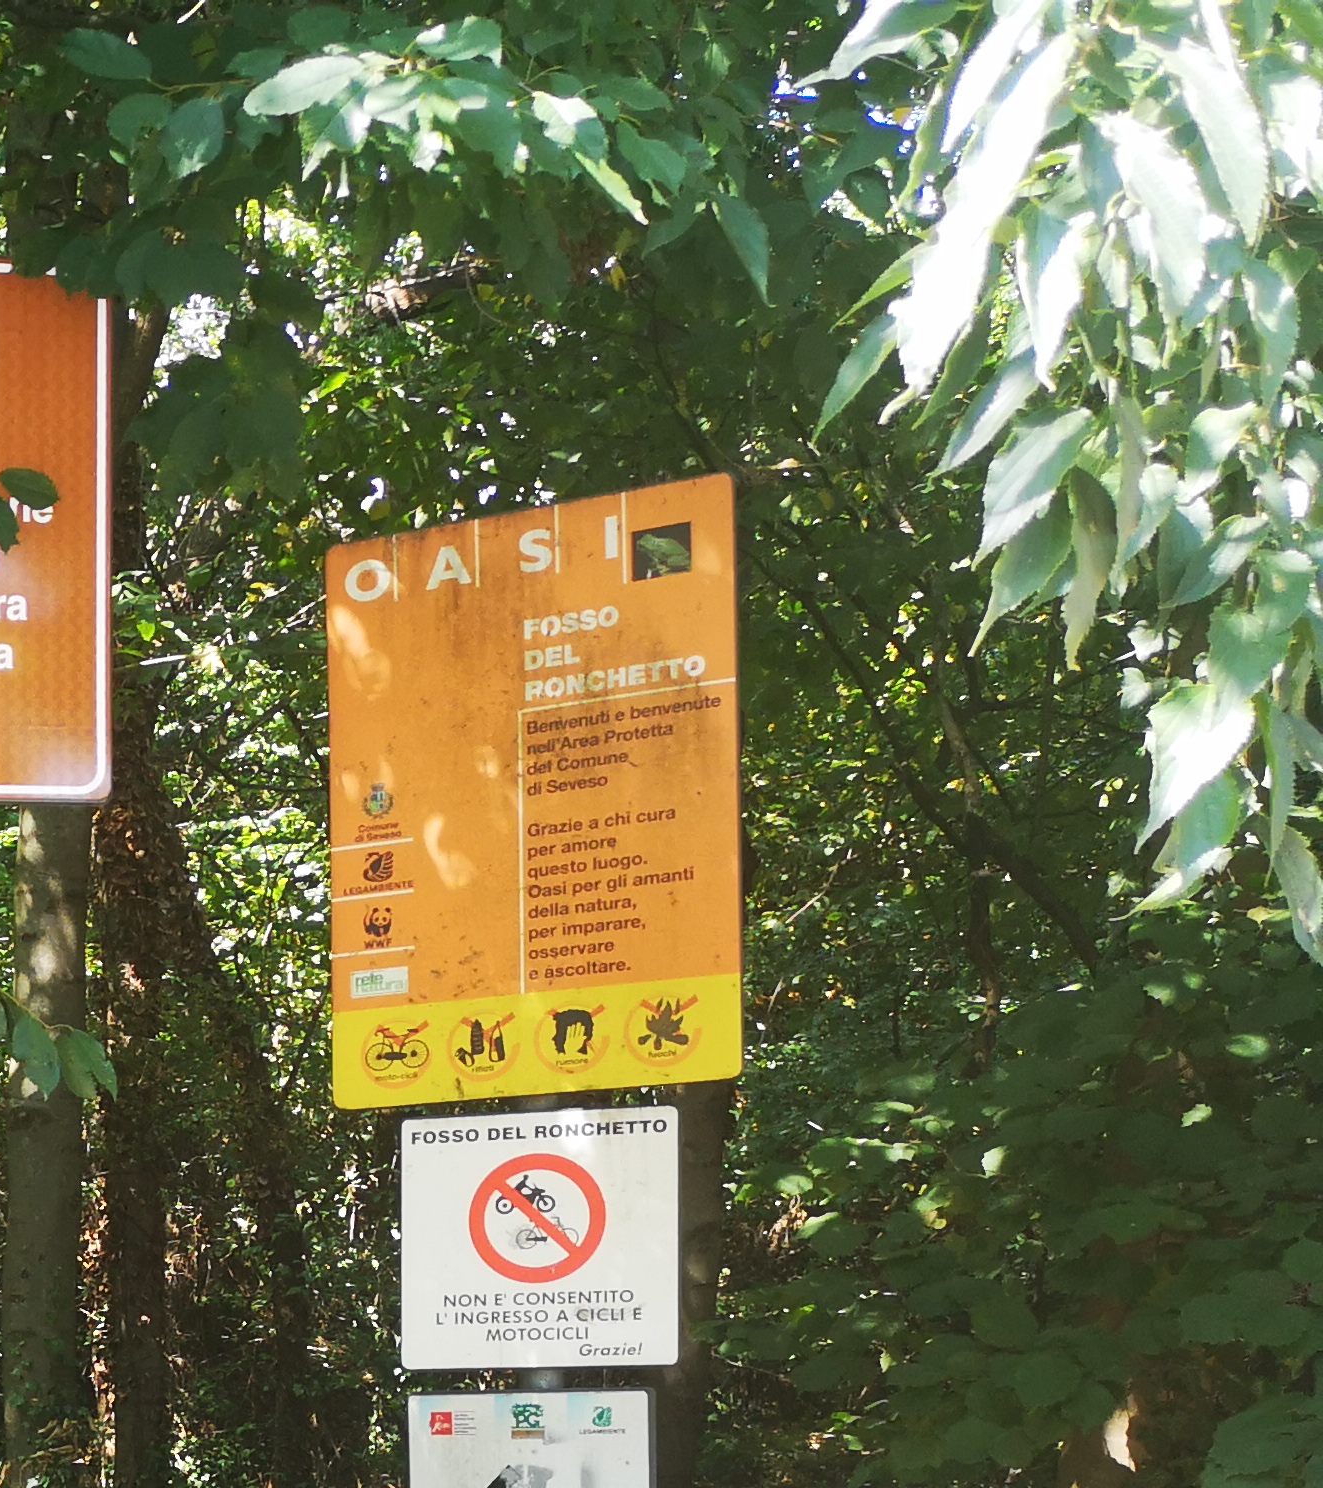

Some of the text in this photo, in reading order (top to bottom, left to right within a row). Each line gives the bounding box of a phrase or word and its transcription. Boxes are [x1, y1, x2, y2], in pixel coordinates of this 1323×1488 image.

[523, 605, 619, 640] FOSSO
[524, 644, 581, 671] DEL
[525, 655, 706, 701] RONCHETTO
[526, 695, 722, 735] Benvenuti e benvenute
[527, 722, 674, 755] nell'Area Protetta
[526, 751, 629, 776] del Comune
[527, 775, 609, 797] di Seveso
[358, 822, 399, 833] Comune
[527, 808, 676, 837] Grazie a chi cura
[367, 831, 402, 841] Seveso
[527, 836, 617, 861] per amore
[527, 854, 648, 880] questo luogo.
[343, 879, 414, 897] LEGAMBIENTE
[528, 866, 695, 899] Oasi per gli amanti
[528, 897, 637, 919] della natura,
[528, 917, 646, 942] per imparare,
[364, 937, 393, 948] WWF
[528, 940, 615, 960] osservare
[355, 972, 384, 987] rete
[529, 960, 631, 980] e ascoltare.
[556, 1057, 589, 1066] rumore
[411, 1119, 667, 1144] FOSSO DEL RONCHETTO
[443, 1290, 634, 1307] NON E' CONSENTITO
[454, 1310, 549, 1325] INGRESSO
[556, 1310, 569, 1322] A
[576, 1308, 625, 1321] CICLI
[633, 1308, 642, 1321] E
[486, 1326, 590, 1342] MOTOCICLI
[578, 1343, 643, 1357] Grazie!
